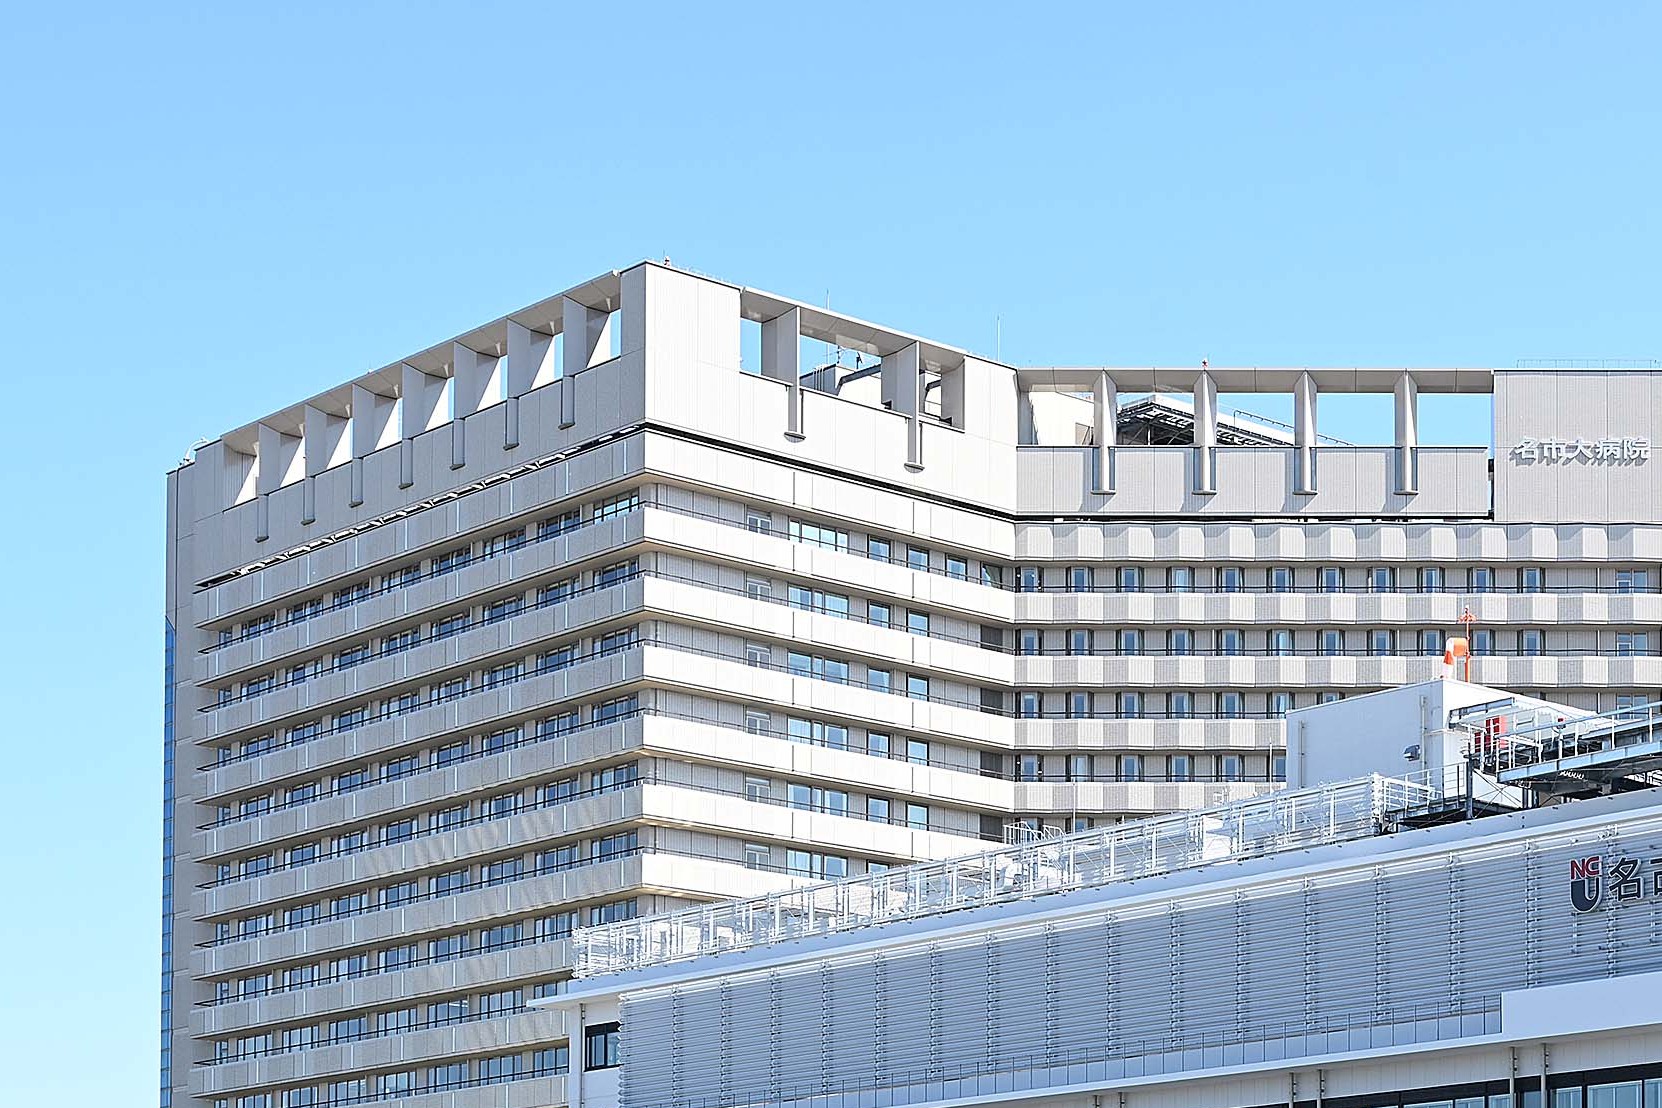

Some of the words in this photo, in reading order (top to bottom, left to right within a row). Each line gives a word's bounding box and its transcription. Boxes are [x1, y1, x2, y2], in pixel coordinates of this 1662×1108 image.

[1514, 438, 1649, 461] 名市大病院
